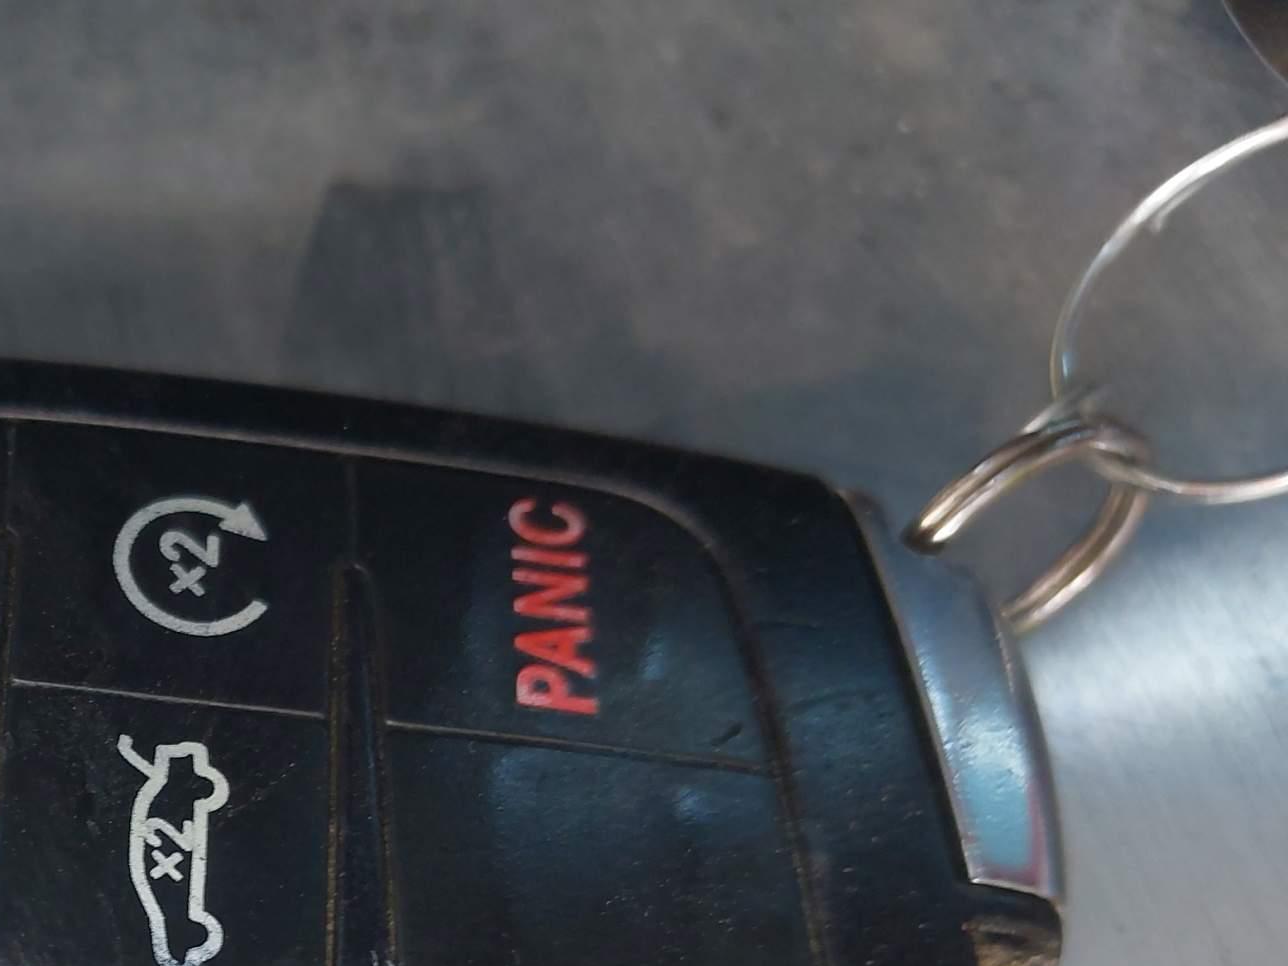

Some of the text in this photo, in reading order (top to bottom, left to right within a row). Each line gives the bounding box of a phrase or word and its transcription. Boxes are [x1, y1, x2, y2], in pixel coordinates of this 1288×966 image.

[159, 530, 220, 597] x2
[508, 498, 599, 715] PANIC
[144, 816, 194, 882] x2
